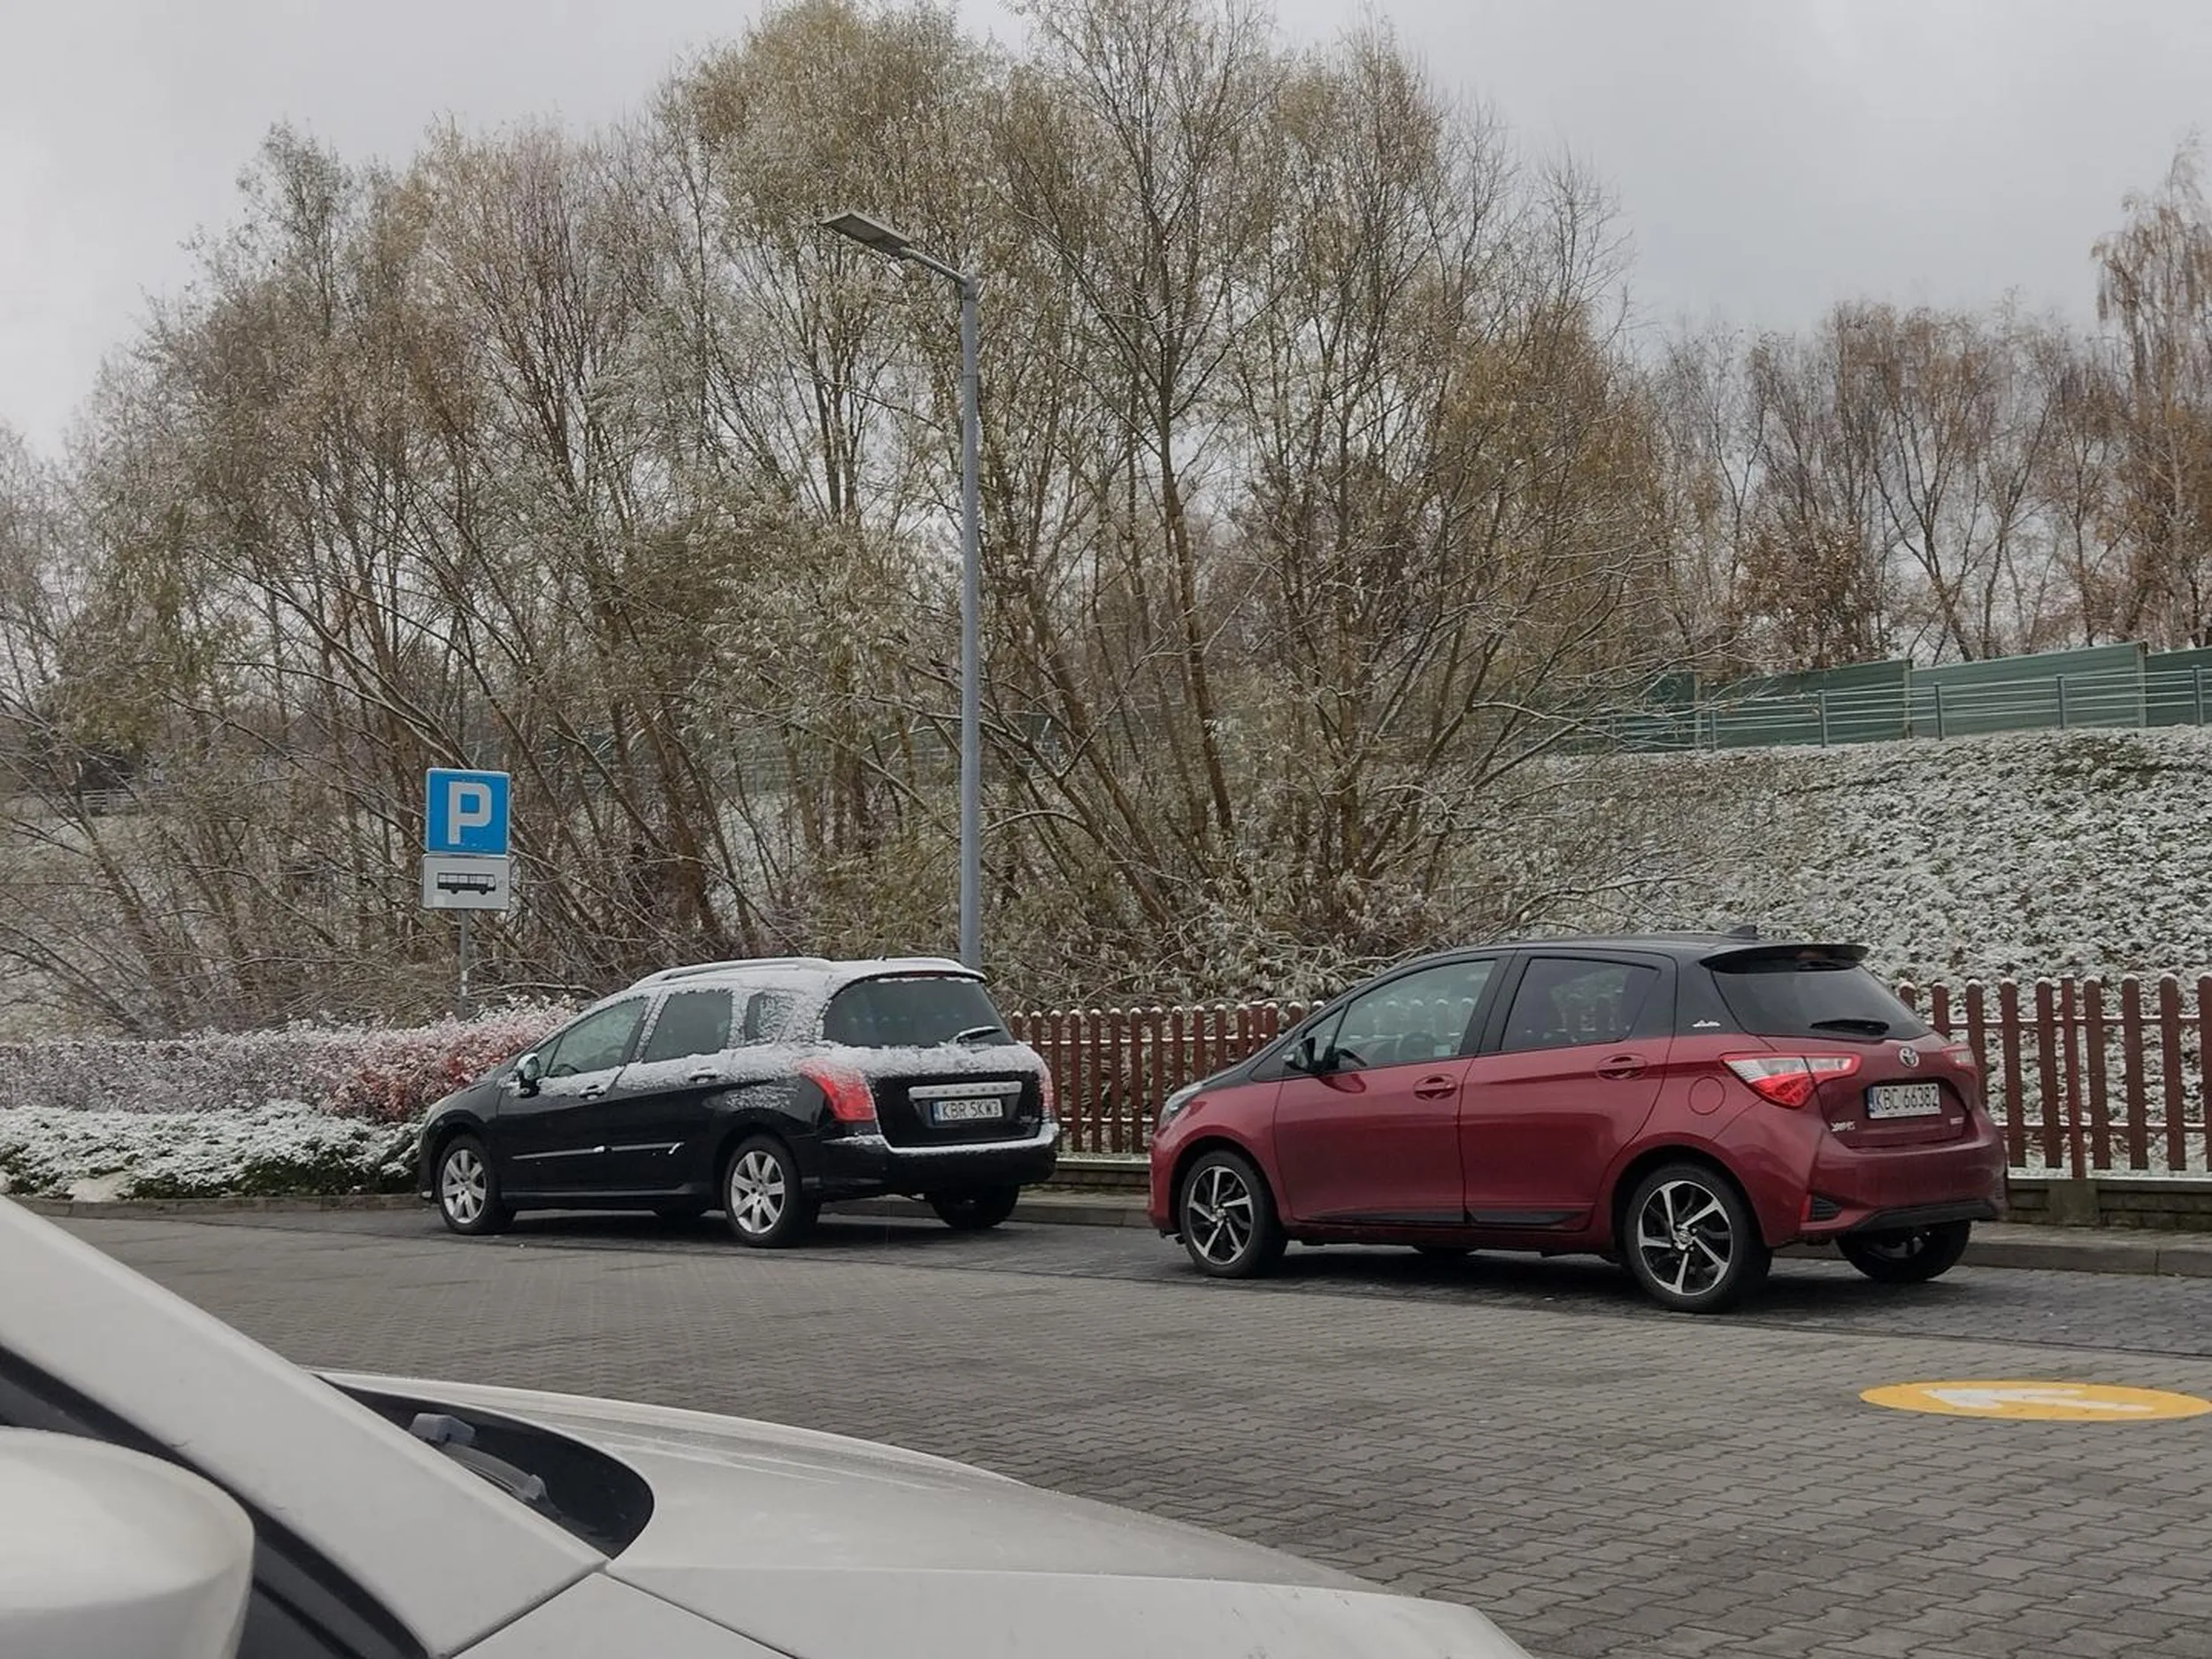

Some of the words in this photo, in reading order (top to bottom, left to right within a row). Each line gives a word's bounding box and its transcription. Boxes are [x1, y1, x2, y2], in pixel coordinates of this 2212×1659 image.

[448, 780, 492, 845] P
[942, 1102, 966, 1118] KBR
[1876, 1088, 1899, 1110] KBC
[1903, 1086, 1938, 1108] 66382
